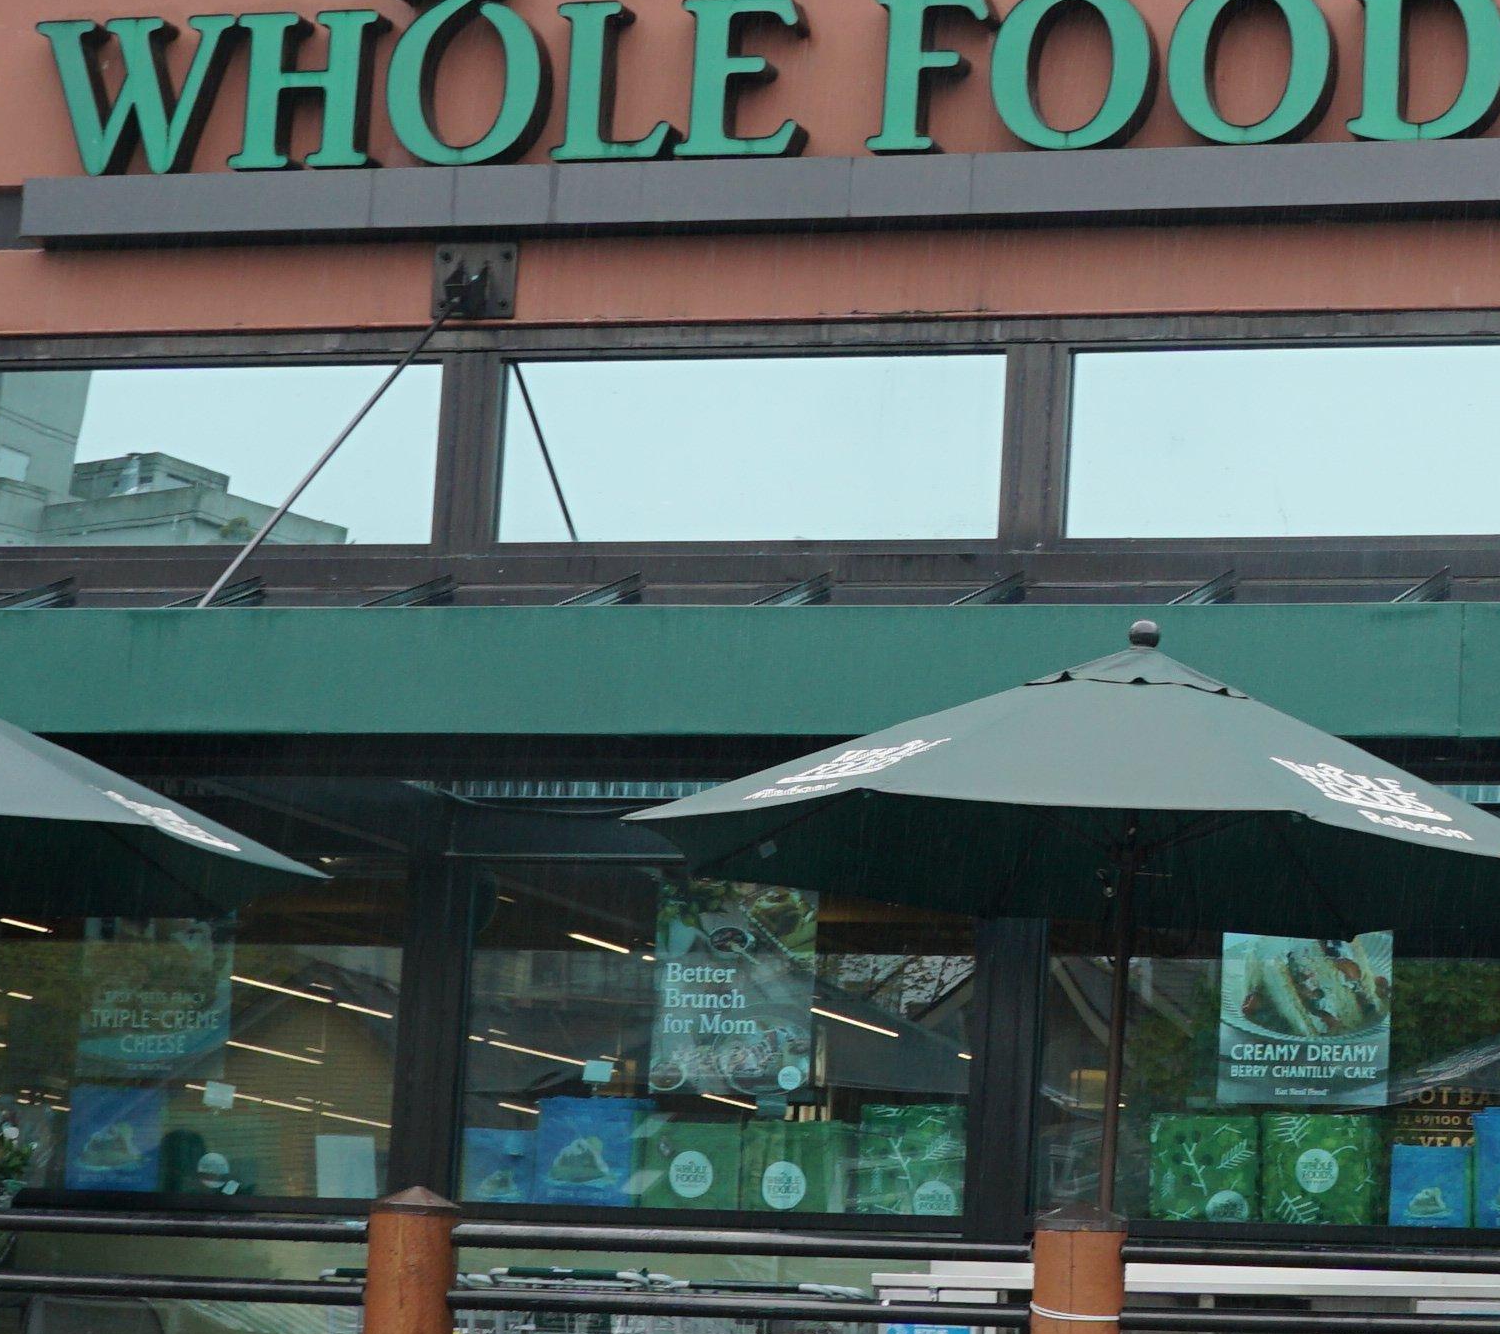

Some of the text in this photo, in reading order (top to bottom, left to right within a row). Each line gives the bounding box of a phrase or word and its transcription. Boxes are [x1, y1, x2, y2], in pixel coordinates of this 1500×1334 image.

[665, 962, 737, 984] Better
[663, 988, 746, 1009] Brunch
[662, 1013, 757, 1035] for Mom
[120, 1034, 187, 1054] CHEESE
[1230, 1043, 1379, 1063] CREAMY DREAMY
[1230, 1064, 1377, 1079] BERRY CHANTILLY CAKE
